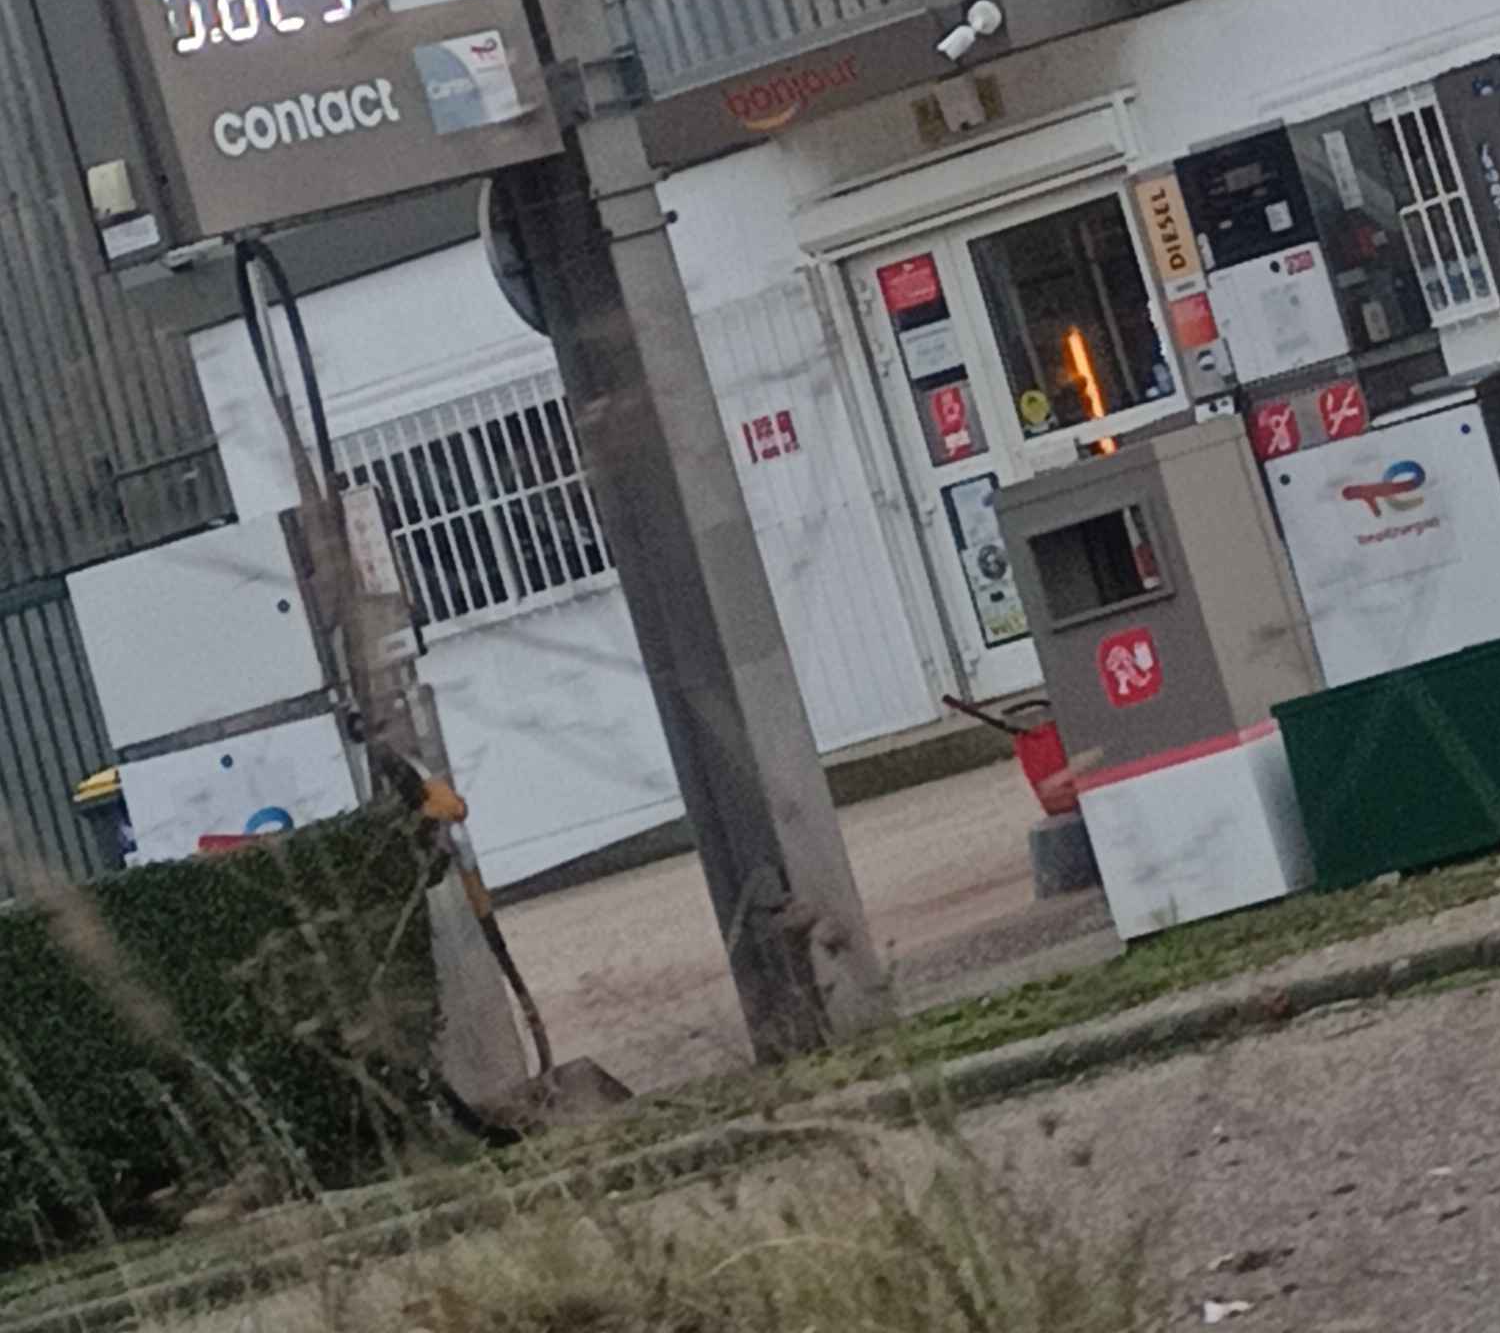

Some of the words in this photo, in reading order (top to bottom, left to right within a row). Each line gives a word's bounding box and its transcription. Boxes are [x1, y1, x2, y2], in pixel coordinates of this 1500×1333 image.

[214, 78, 400, 157] contact
[721, 53, 857, 118] bonjour
[1151, 188, 1187, 271] DIESEL
